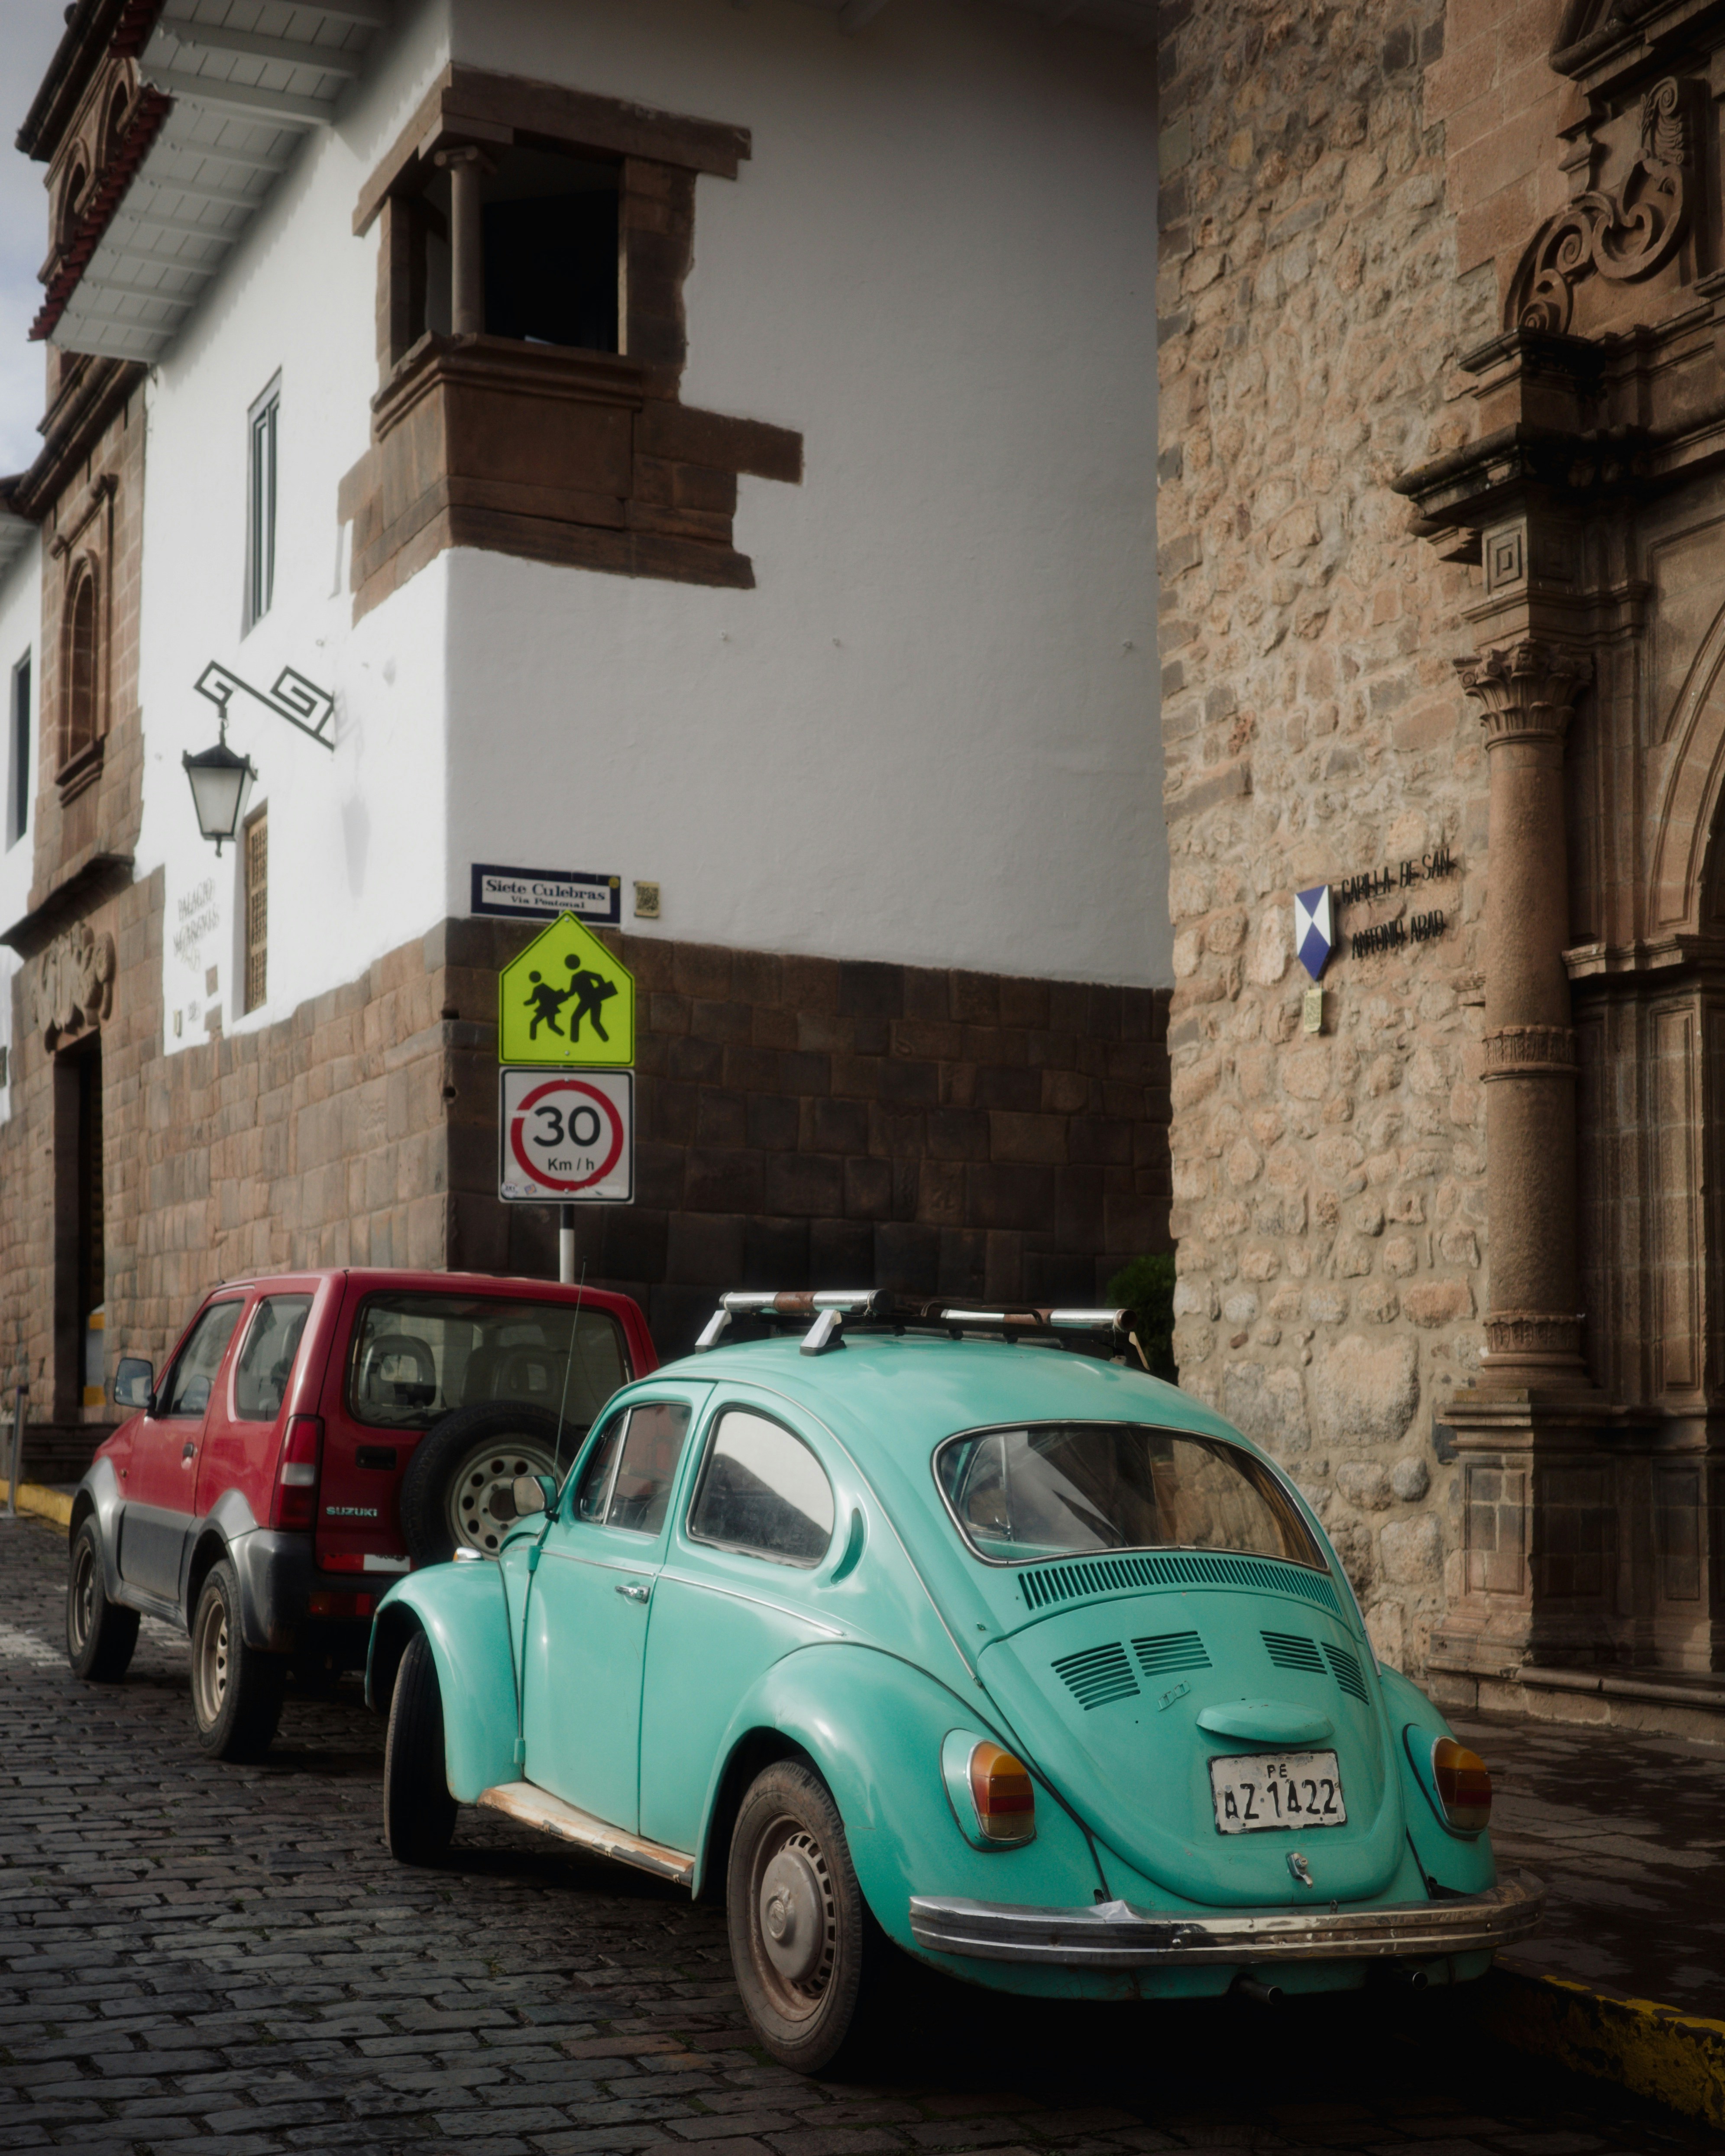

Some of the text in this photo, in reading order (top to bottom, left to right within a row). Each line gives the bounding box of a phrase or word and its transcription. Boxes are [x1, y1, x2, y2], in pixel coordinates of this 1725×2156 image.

[485, 879, 605, 900] Siete Culebras
[1341, 848, 1450, 904] CAPILLA DE SAN
[1352, 910, 1443, 959] ANTONIO ABAD
[533, 1106, 601, 1147] 30
[326, 1506, 377, 1516] SUZUKI
[1267, 1764, 1287, 1778] PE
